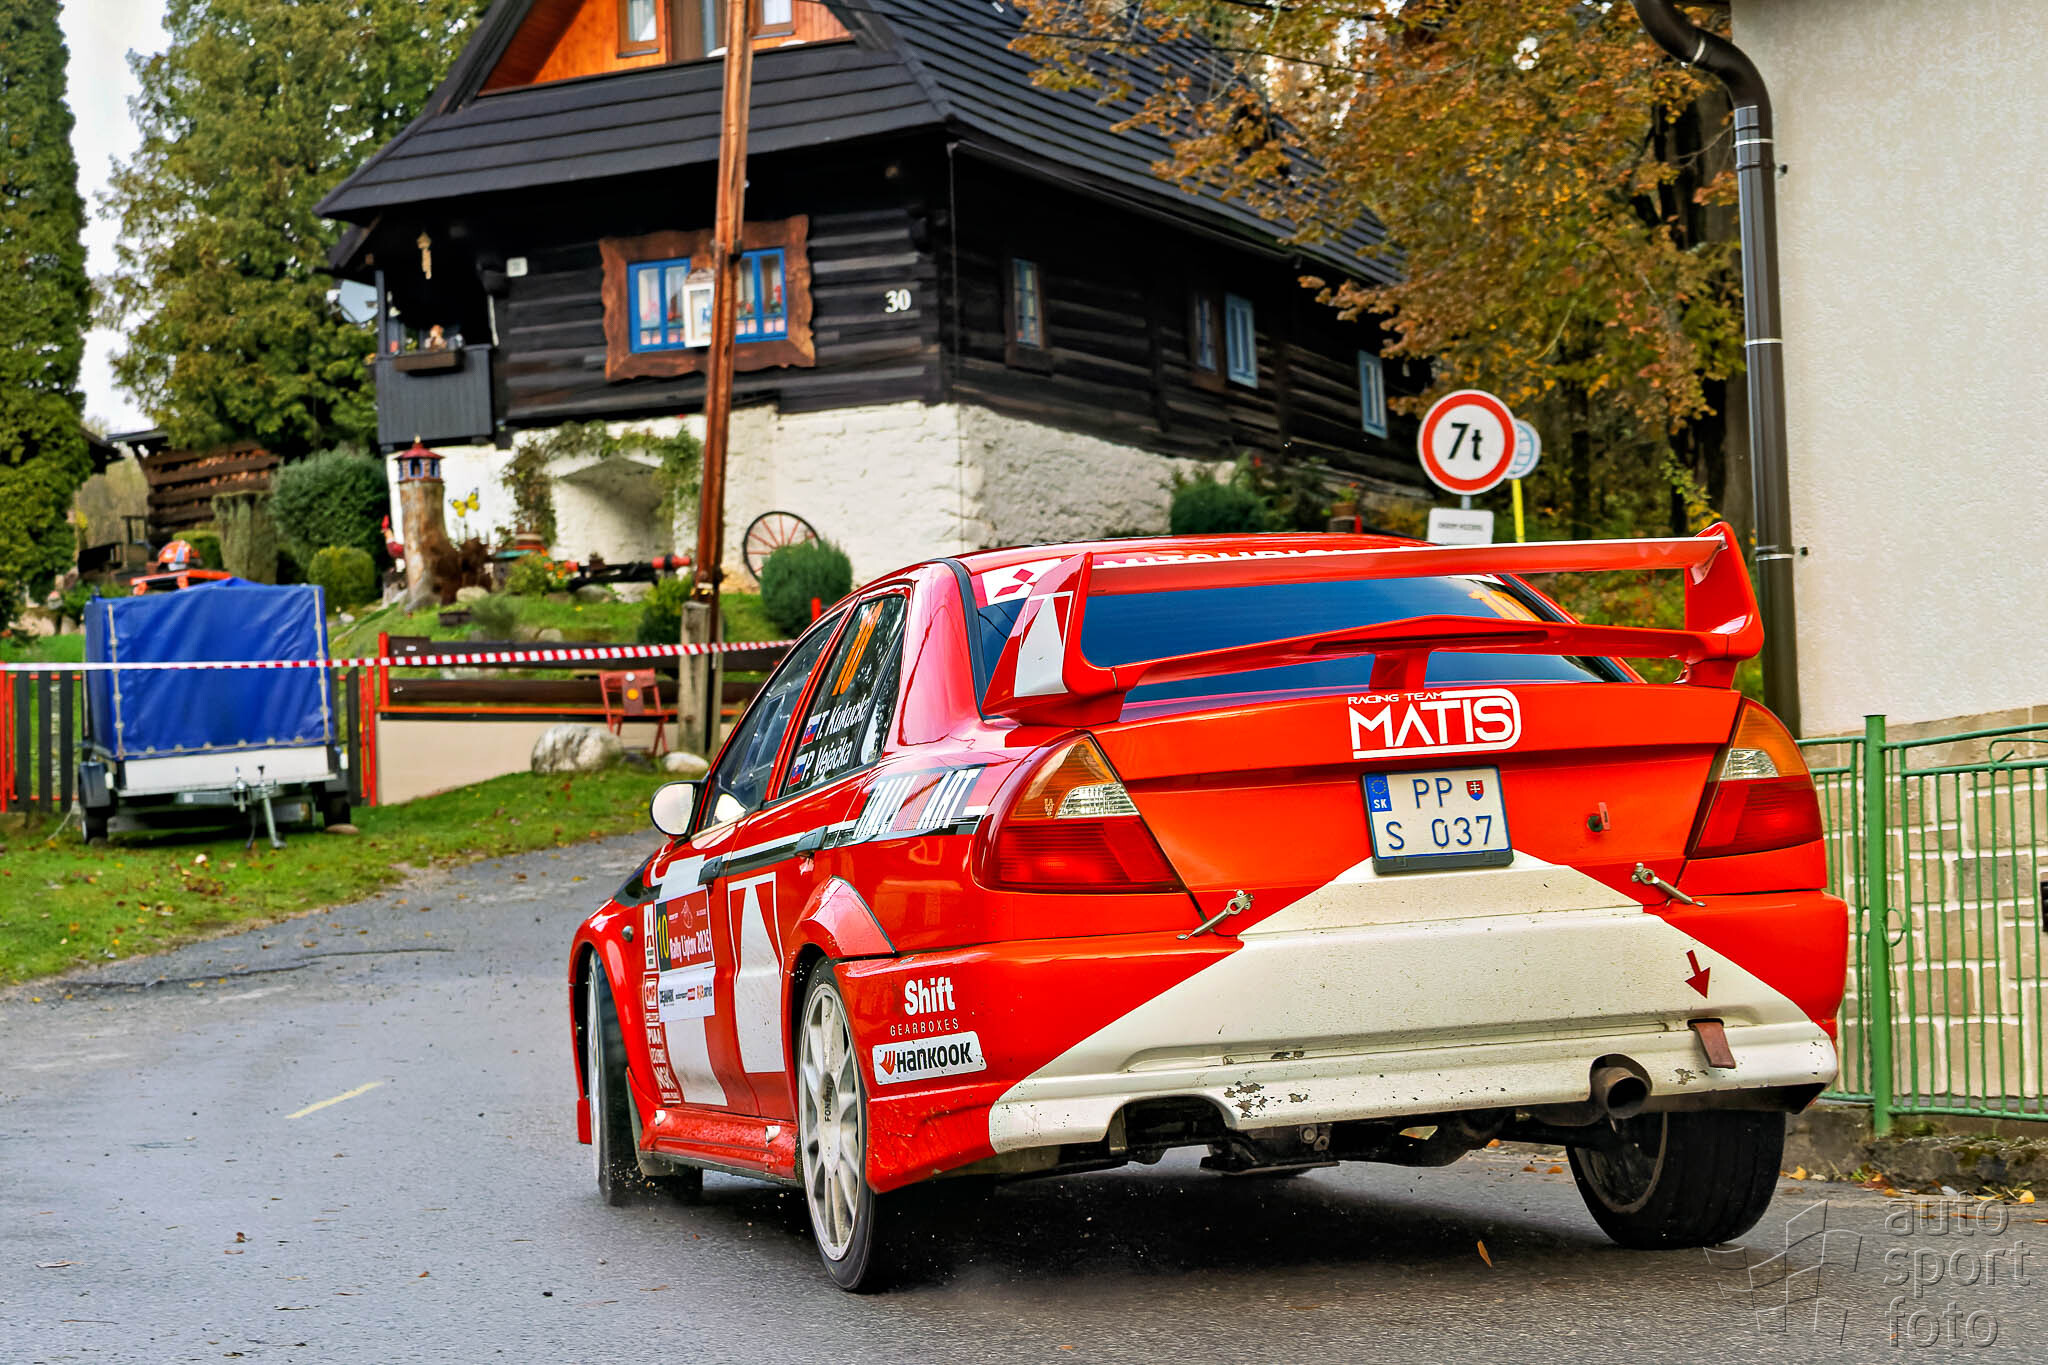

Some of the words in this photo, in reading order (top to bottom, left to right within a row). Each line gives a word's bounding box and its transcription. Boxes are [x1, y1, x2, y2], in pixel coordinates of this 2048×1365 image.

[885, 289, 911, 312] 30
[1448, 422, 1483, 461] 7t
[832, 600, 884, 696] 10
[1348, 694, 1399, 705] RACING
[1404, 692, 1443, 701] TEAM
[816, 710, 830, 740] T.
[1349, 697, 1514, 750] MATIS
[801, 751, 815, 781] P.
[1373, 799, 1388, 809] SK
[1412, 777, 1452, 809] PP
[1385, 820, 1405, 850] S
[1431, 815, 1492, 847] 037
[657, 914, 669, 959] 10
[904, 976, 956, 1016] Shift
[890, 1018, 959, 1036] GEARBOXES
